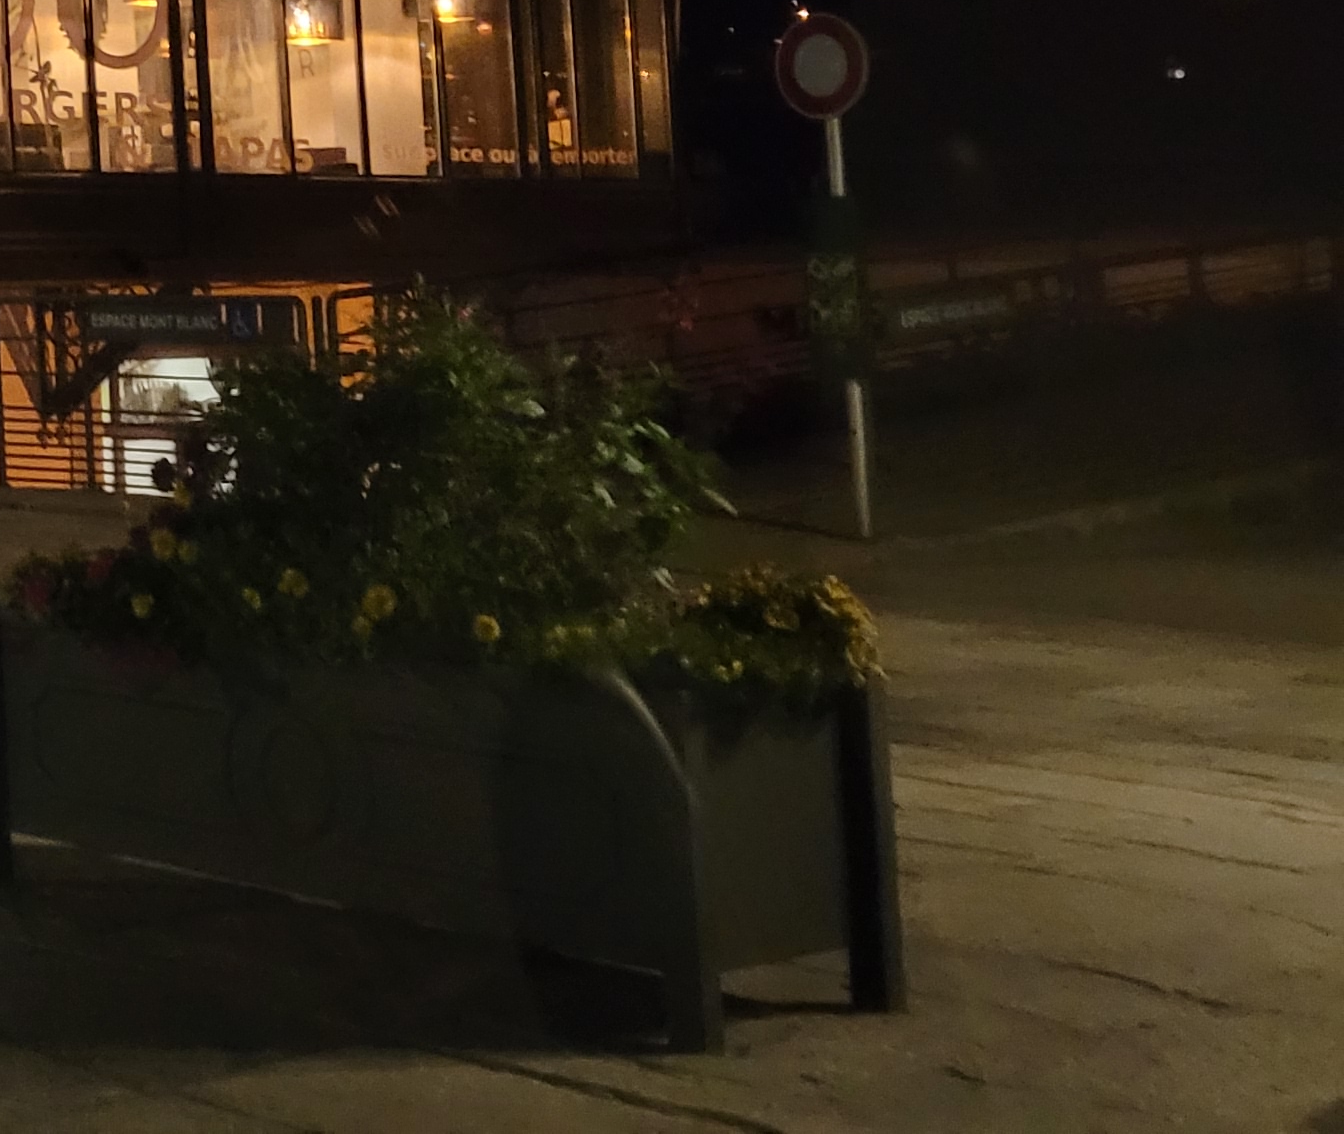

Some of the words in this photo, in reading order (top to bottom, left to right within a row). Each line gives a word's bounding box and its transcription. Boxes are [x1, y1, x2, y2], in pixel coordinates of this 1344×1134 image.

[424, 145, 484, 167] pace
[489, 148, 515, 164] ou
[139, 313, 173, 330] MONT
[176, 314, 218, 331] BLANC
